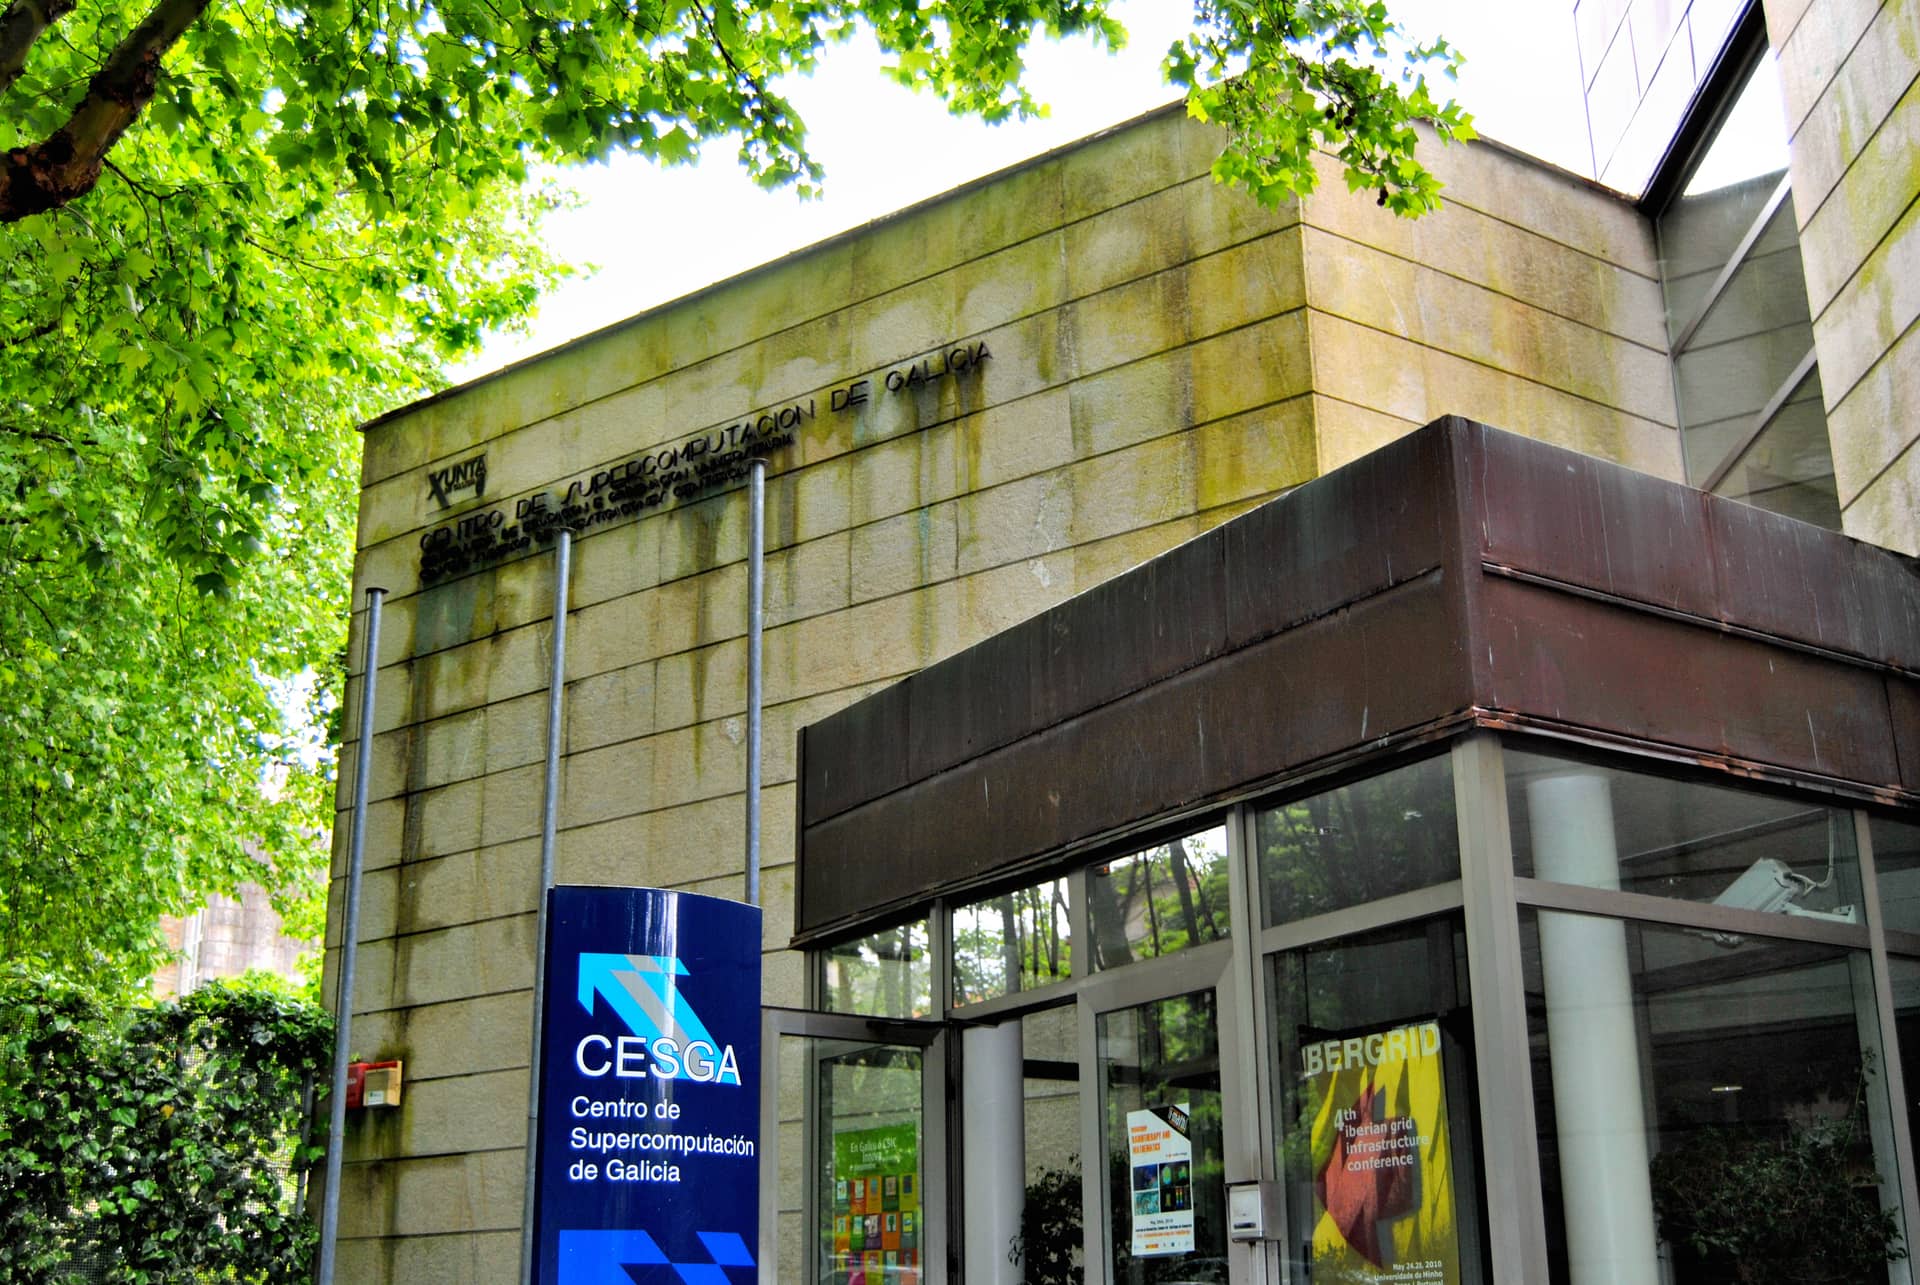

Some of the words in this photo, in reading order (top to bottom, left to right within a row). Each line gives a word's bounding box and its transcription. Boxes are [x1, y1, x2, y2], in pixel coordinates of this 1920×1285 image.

[517, 492, 548, 520] DE
[561, 399, 815, 505] SUPERCOMPUTACION
[832, 381, 868, 412] DE
[886, 341, 993, 391] GALICIA
[427, 453, 487, 510] XUNTA
[575, 1034, 742, 1086] CESGA
[1302, 1023, 1441, 1077] IBERGRID
[571, 1096, 648, 1118] Centro
[654, 1099, 681, 1119] de
[1334, 1108, 1357, 1131] 4th
[1345, 1122, 1388, 1138] iberian
[1390, 1117, 1413, 1134] grid
[570, 1127, 755, 1156] Supercomputación
[1346, 1135, 1430, 1154] infrastructure
[569, 1159, 598, 1180] de
[605, 1159, 681, 1182] Galicia
[1347, 1154, 1414, 1171] conference
